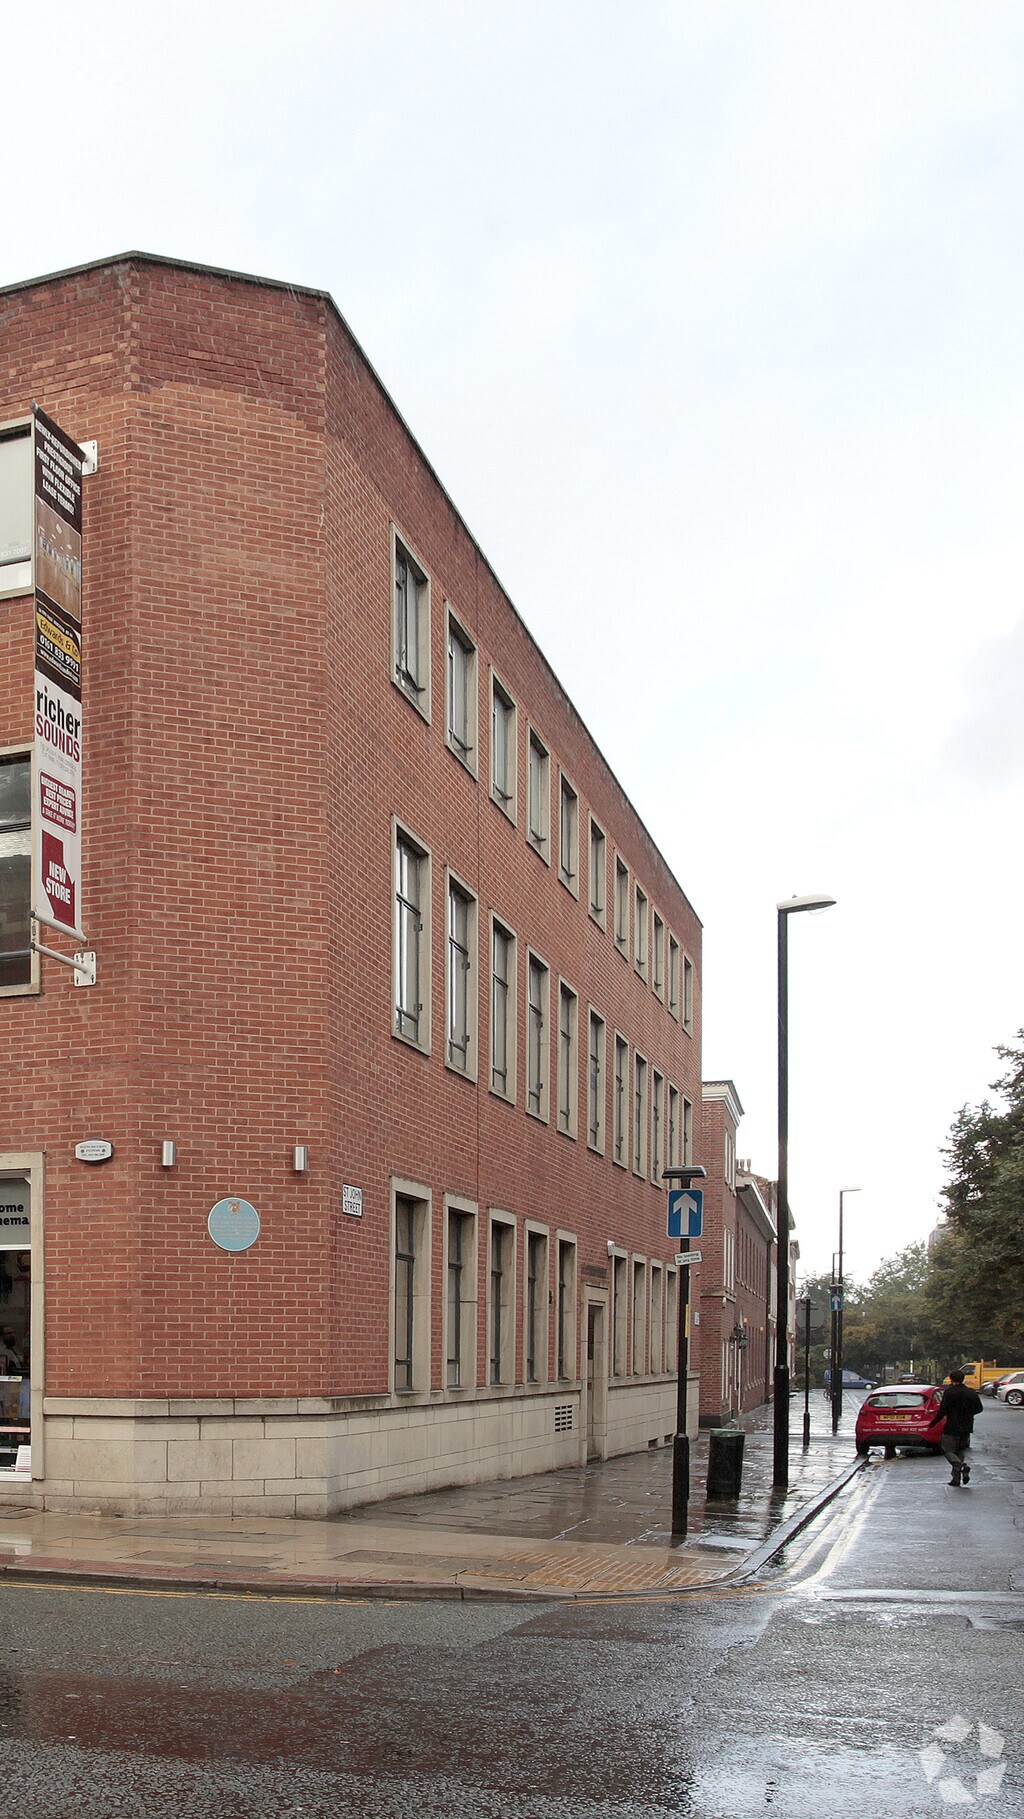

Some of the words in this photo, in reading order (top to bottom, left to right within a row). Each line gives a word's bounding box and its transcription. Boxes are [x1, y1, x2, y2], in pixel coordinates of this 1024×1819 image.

[36, 446, 50, 466] FIRST
[49, 459, 65, 481] FLOOR
[65, 474, 81, 496] OFFICE
[42, 479, 57, 500] LEASE
[40, 619, 64, 646] Edwards
[65, 640, 71, 651] &
[40, 635, 53, 652] 0161
[37, 685, 80, 739] richer
[36, 714, 80, 762] SOUNDS
[49, 860, 66, 884] NEW
[46, 877, 71, 905] STORE
[343, 1186, 349, 1198] ST
[344, 1200, 361, 1214] STREET
